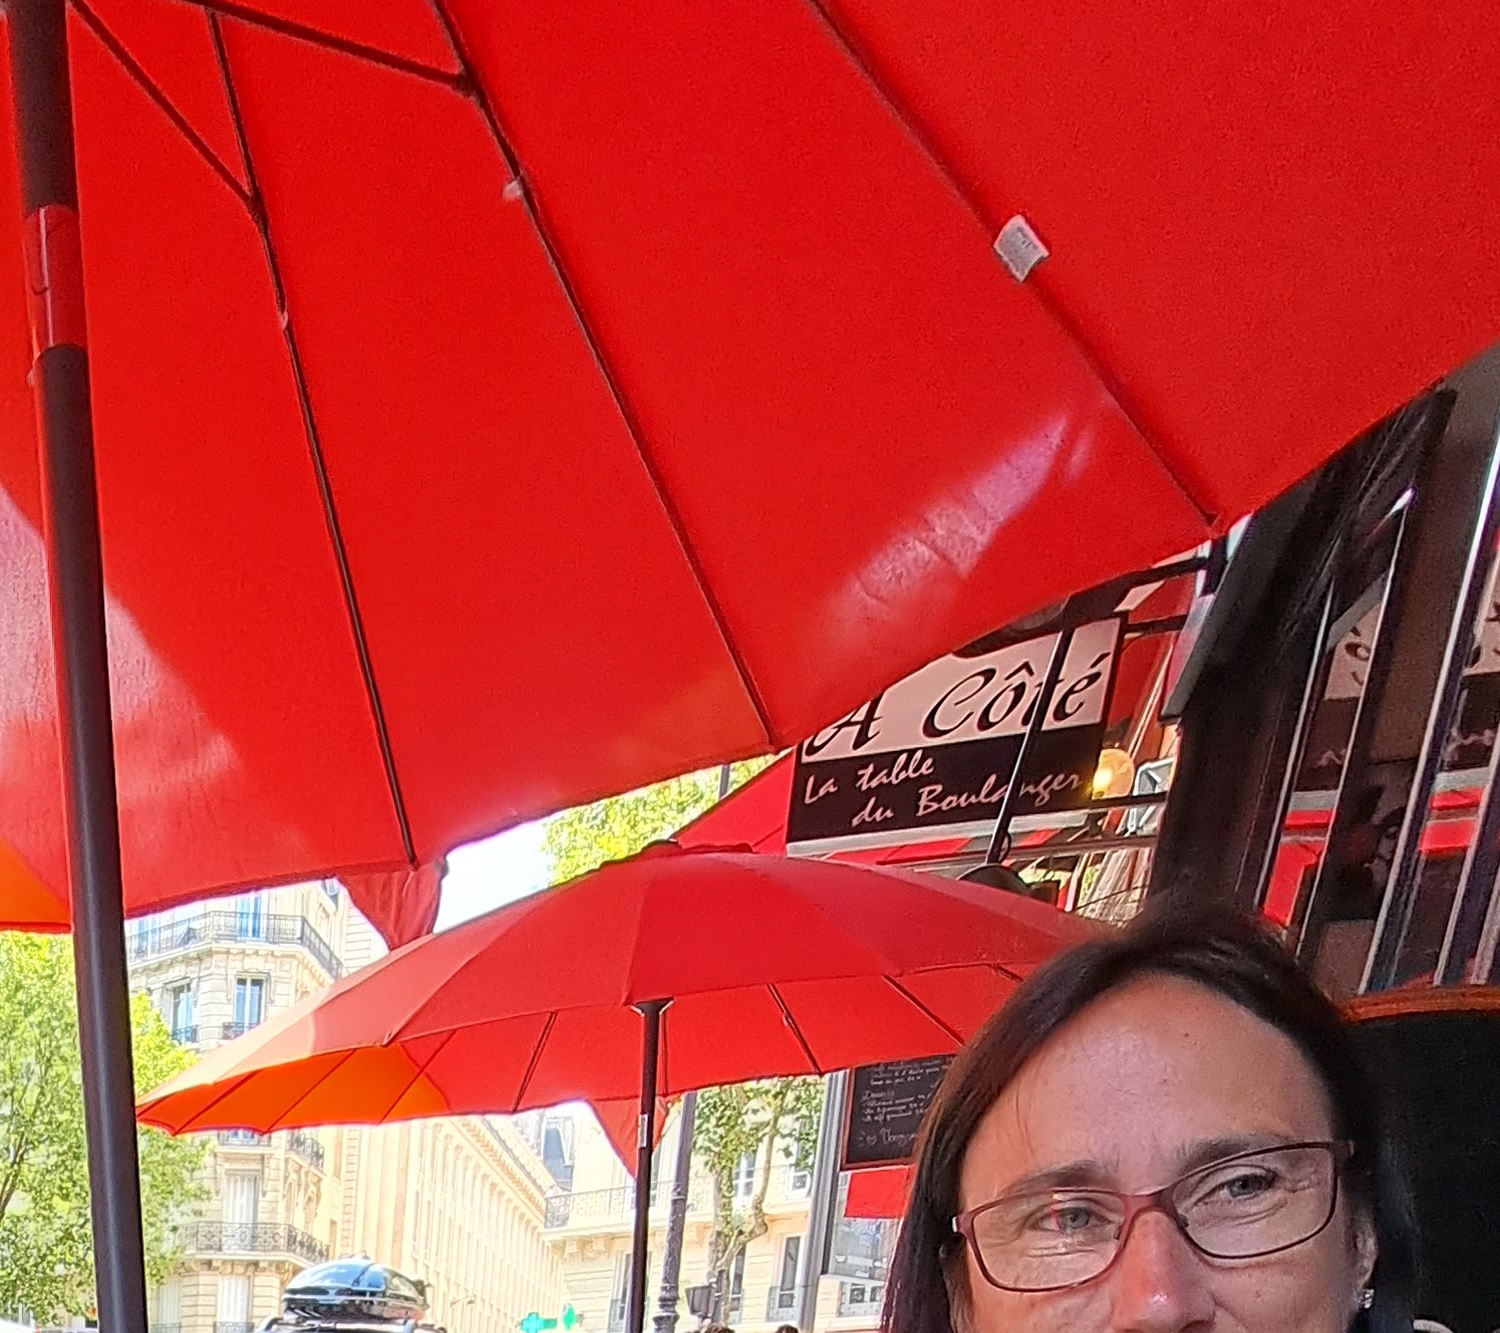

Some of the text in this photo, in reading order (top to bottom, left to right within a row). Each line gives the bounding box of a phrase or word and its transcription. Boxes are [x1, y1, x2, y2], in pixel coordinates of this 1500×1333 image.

[804, 749, 934, 804] La table
[851, 772, 1082, 827] du Boulanger
